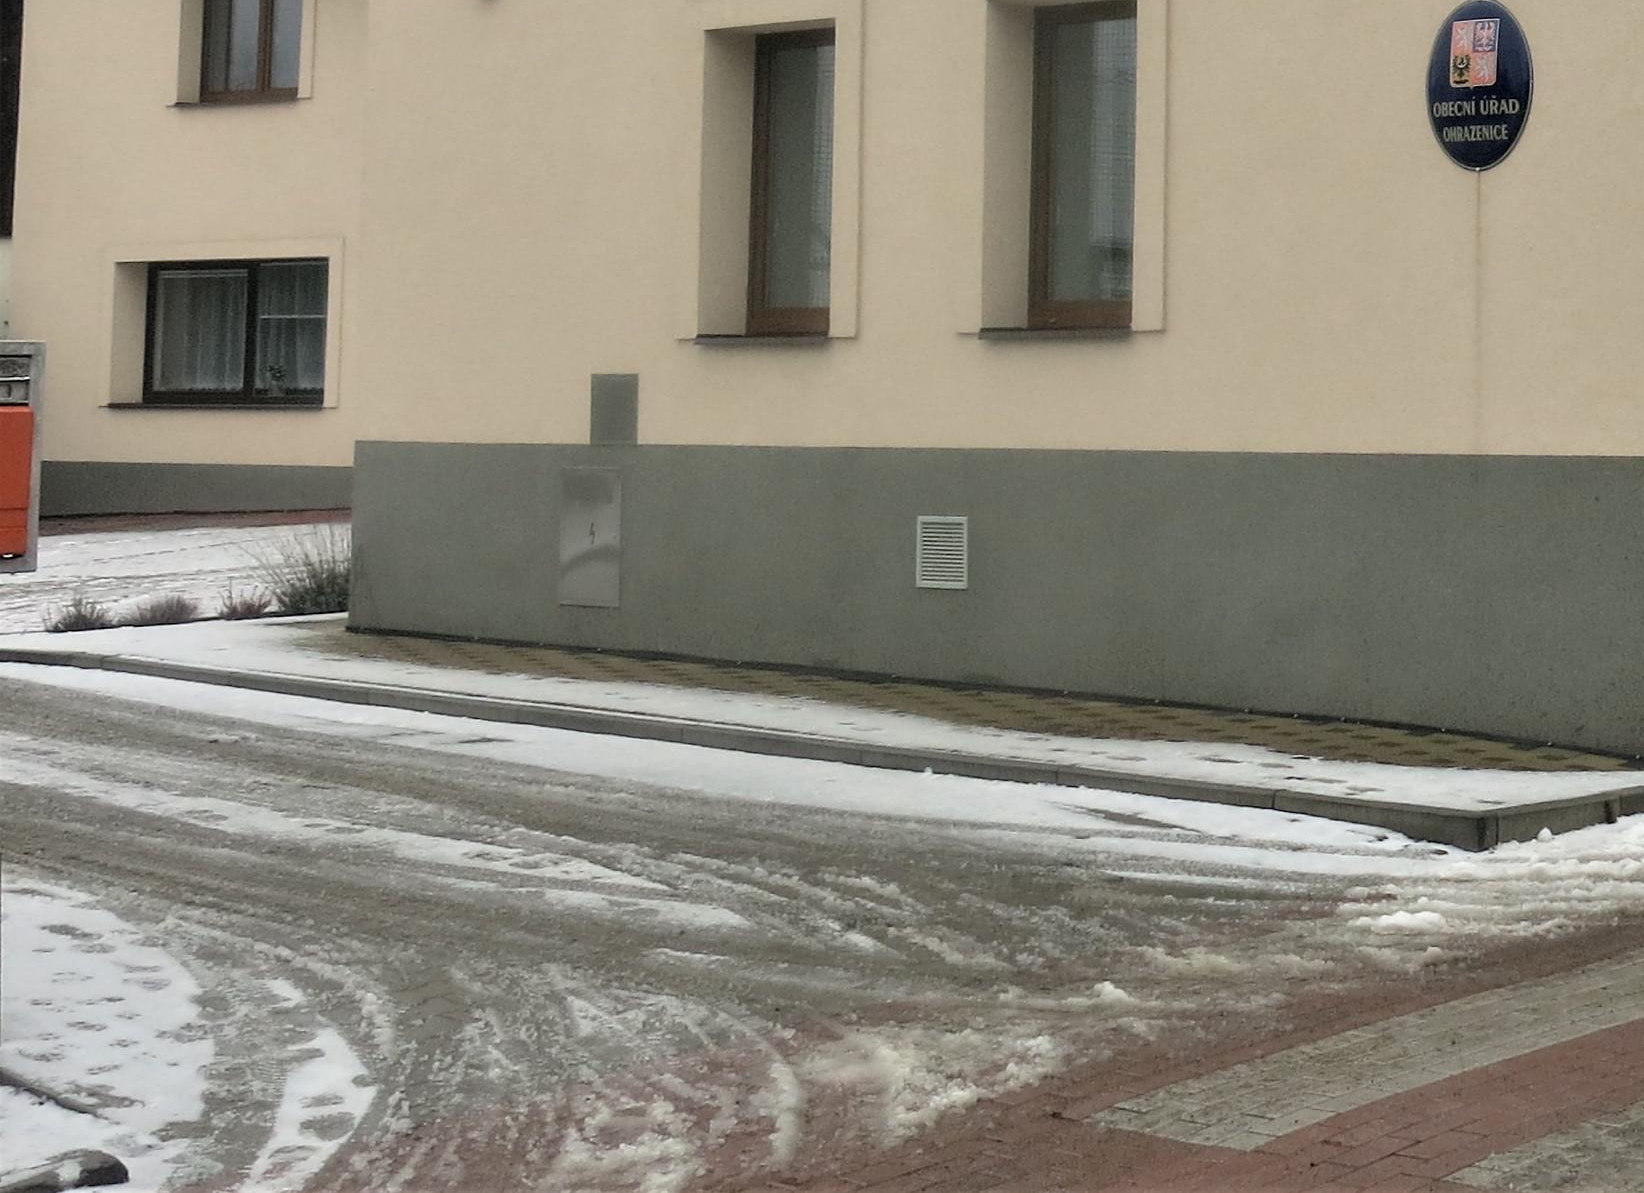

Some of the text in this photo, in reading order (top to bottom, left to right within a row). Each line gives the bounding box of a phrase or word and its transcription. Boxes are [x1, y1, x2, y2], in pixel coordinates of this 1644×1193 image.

[1433, 95, 1520, 118] OBECNÍ ÚŘAD
[1443, 124, 1509, 142] OHRAZENICE
